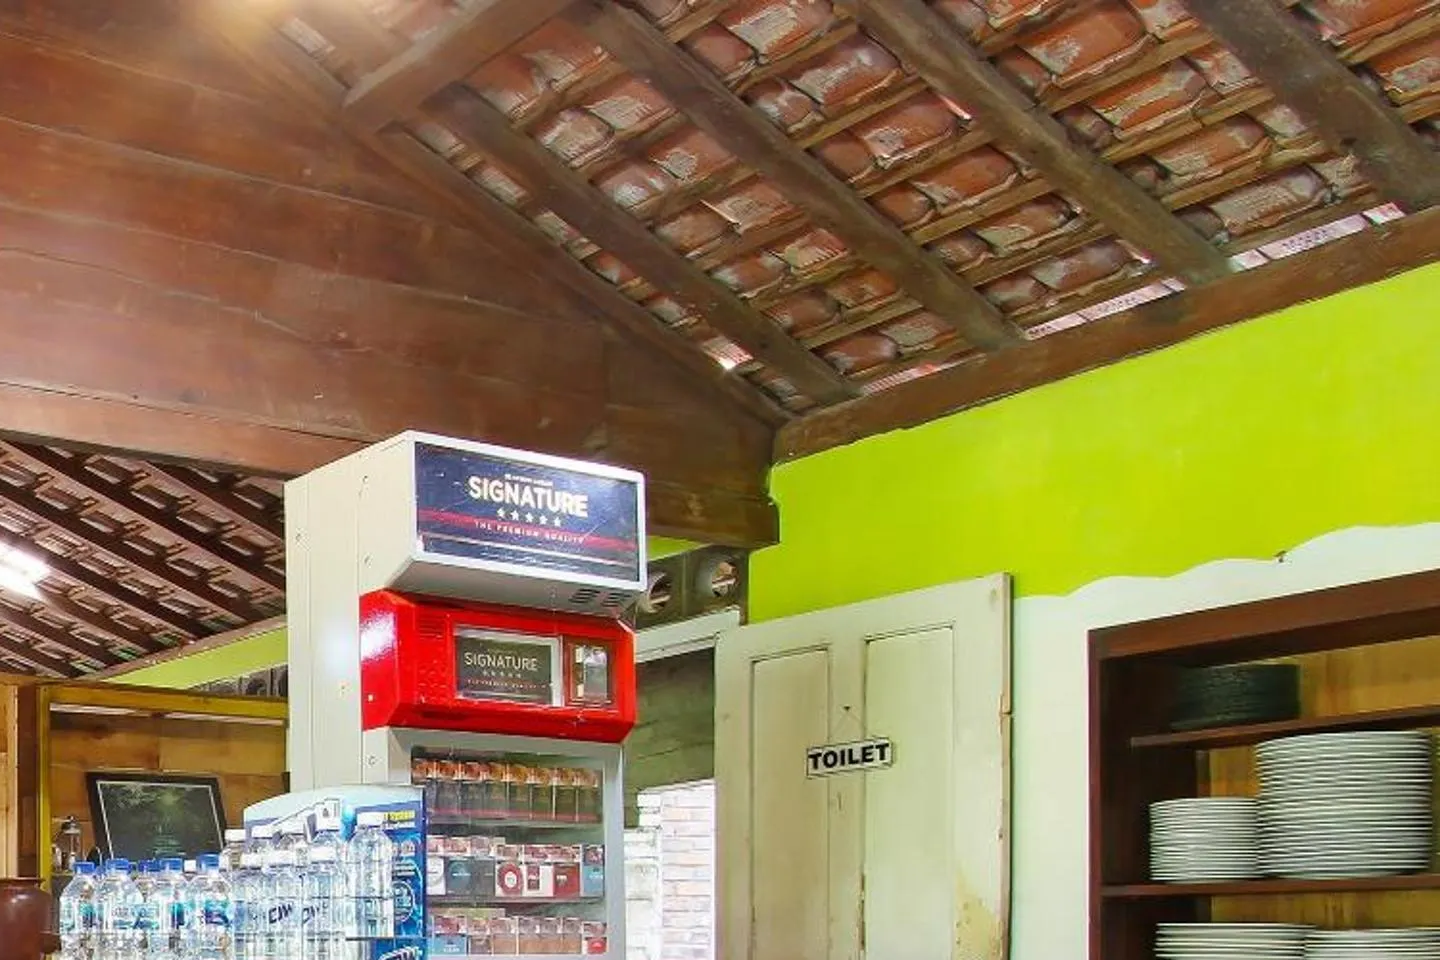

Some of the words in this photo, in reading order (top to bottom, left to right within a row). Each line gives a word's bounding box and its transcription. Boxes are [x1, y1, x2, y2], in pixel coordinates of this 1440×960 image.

[467, 475, 589, 518] SIGNATURE
[473, 519, 493, 531] THE
[496, 525, 540, 537] PREMIUM
[545, 532, 586, 544] QUALITY
[464, 652, 539, 671] SIGNATURE
[808, 743, 890, 770] TOILET
